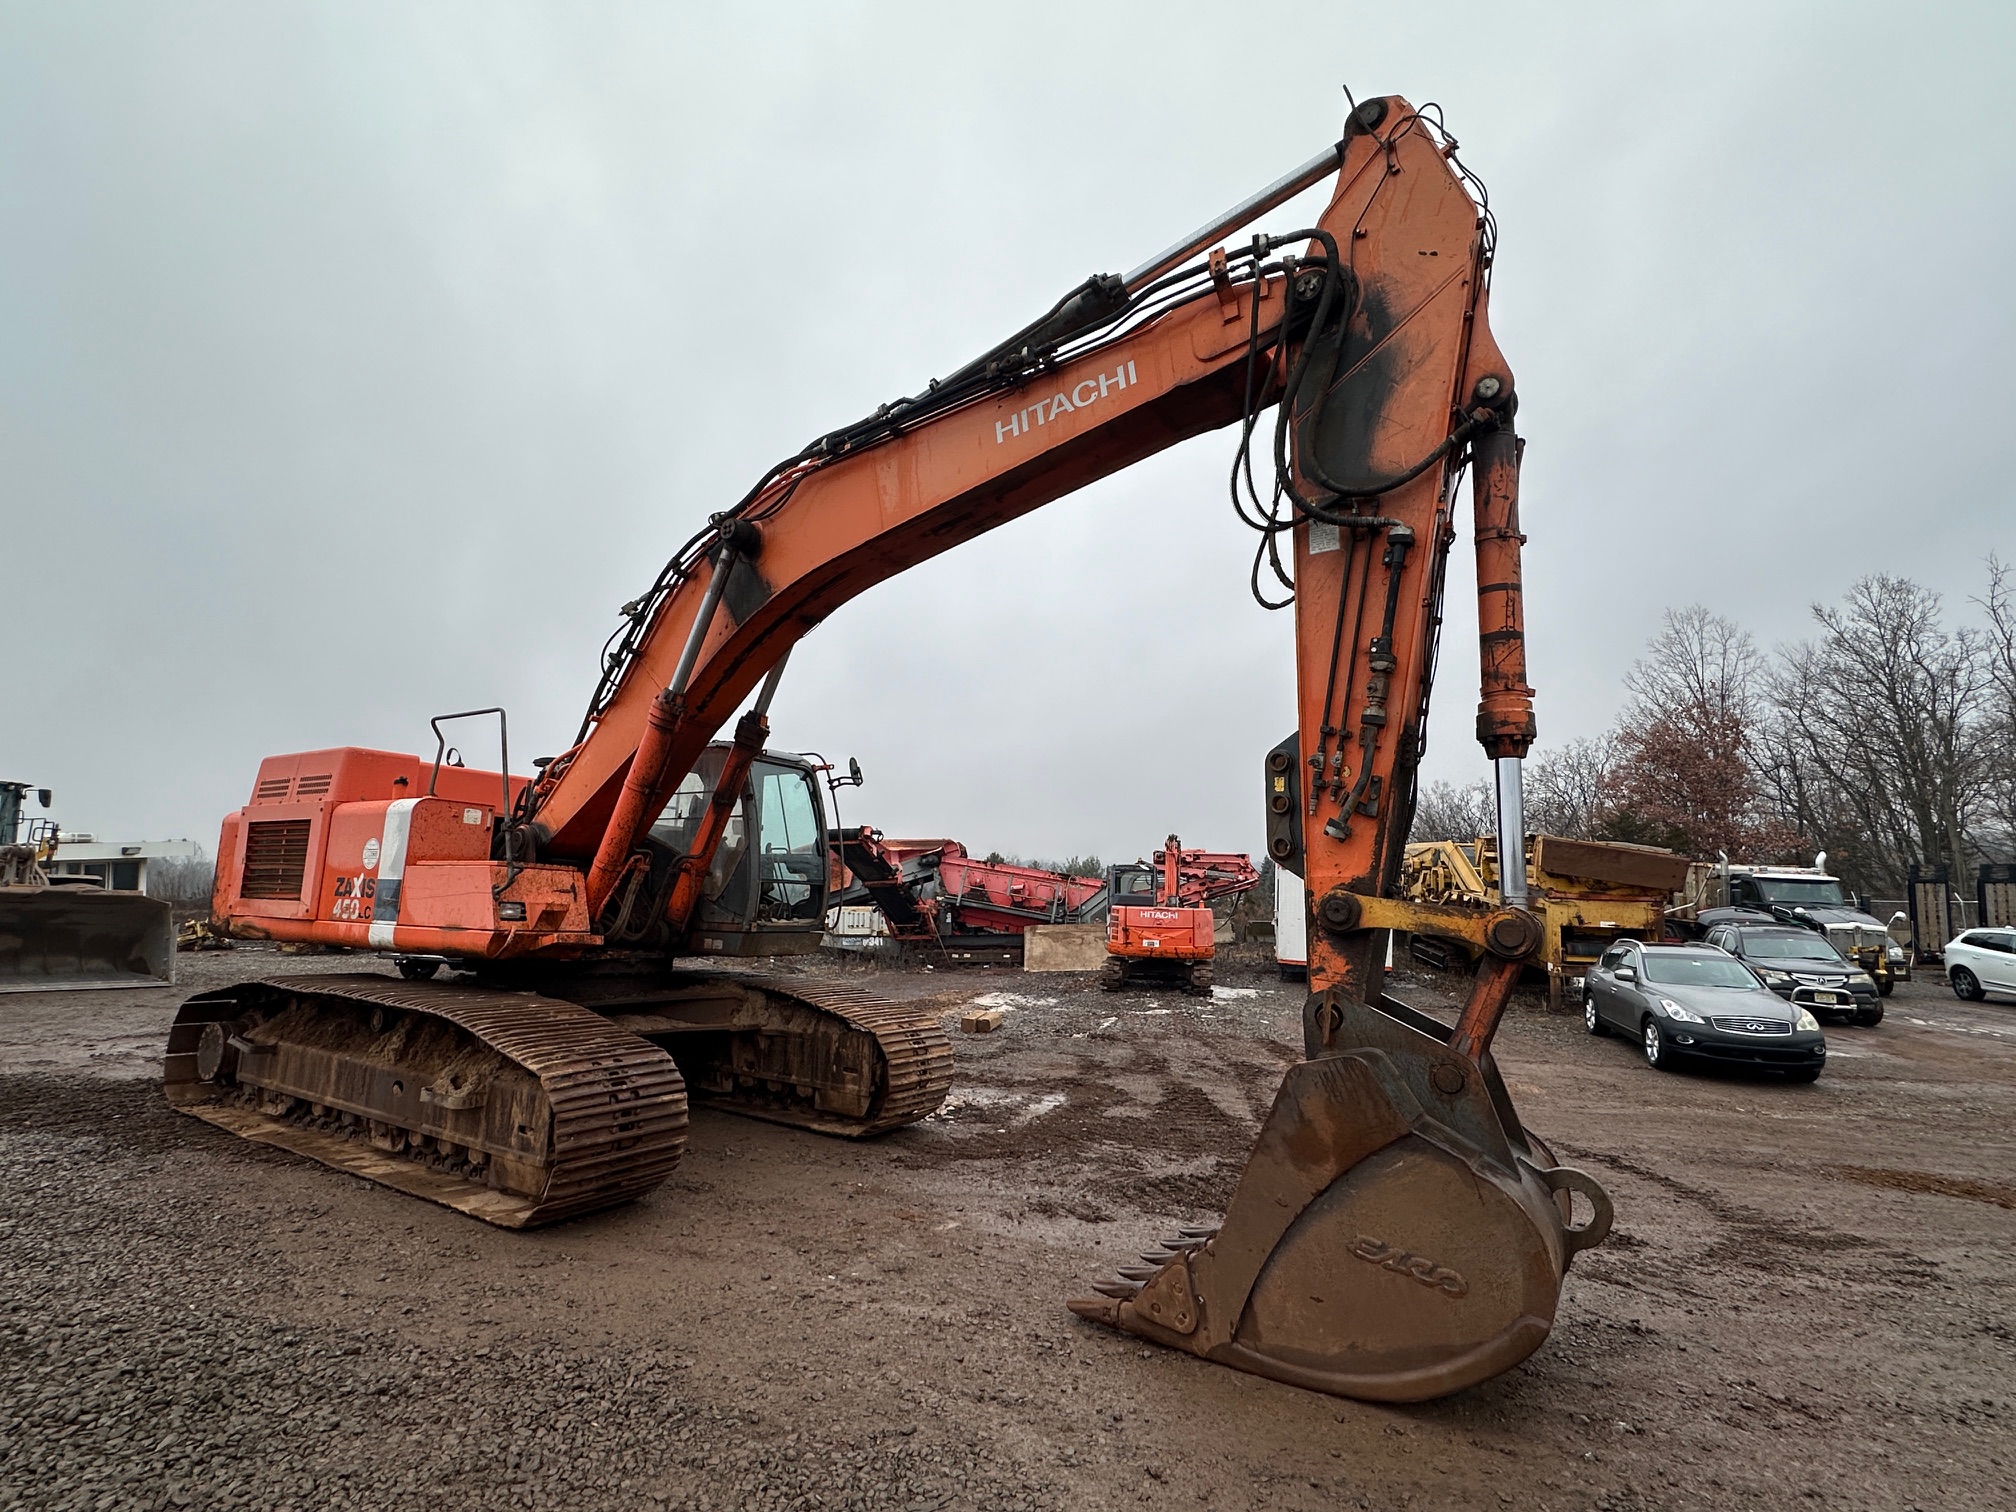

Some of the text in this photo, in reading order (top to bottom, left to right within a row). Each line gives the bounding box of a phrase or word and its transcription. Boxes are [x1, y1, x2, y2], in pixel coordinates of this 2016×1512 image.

[995, 360, 1137, 443] HITACHI
[334, 873, 376, 898] ZAXIS
[1140, 911, 1179, 919] HITACHI
